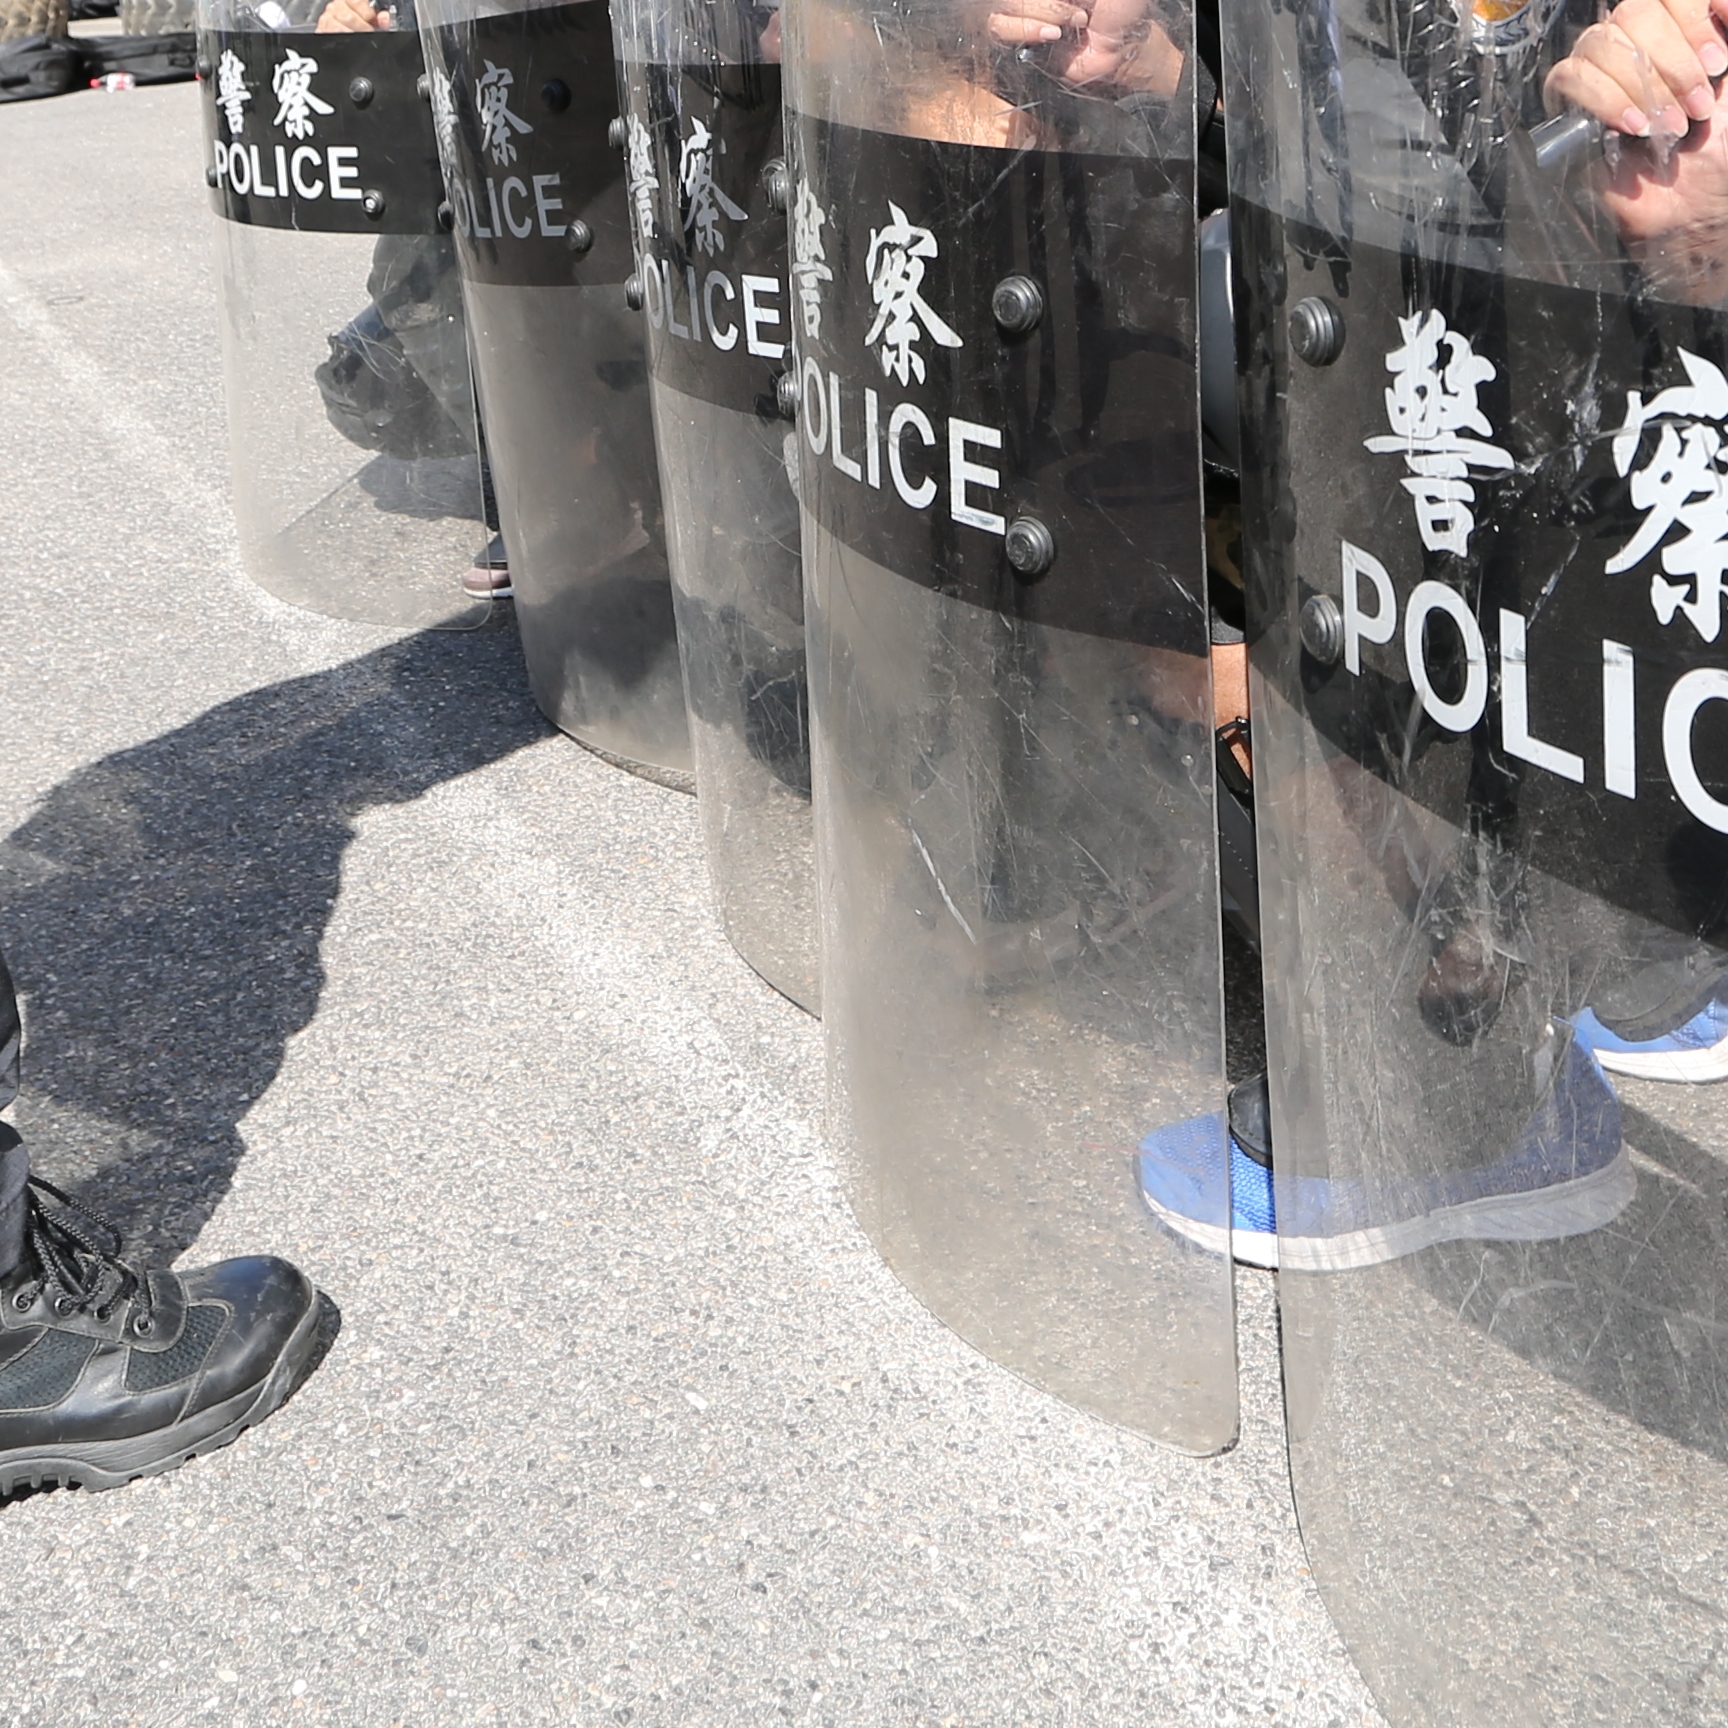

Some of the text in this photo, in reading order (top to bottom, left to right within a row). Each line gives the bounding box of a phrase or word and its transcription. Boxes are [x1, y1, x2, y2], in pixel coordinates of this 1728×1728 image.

[215, 48, 336, 141] 警察
[214, 139, 364, 202] POLICE
[448, 172, 569, 239] OLICE
[636, 248, 787, 360] OLICE
[791, 178, 965, 388] 警察
[795, 353, 1008, 537] OLICE
